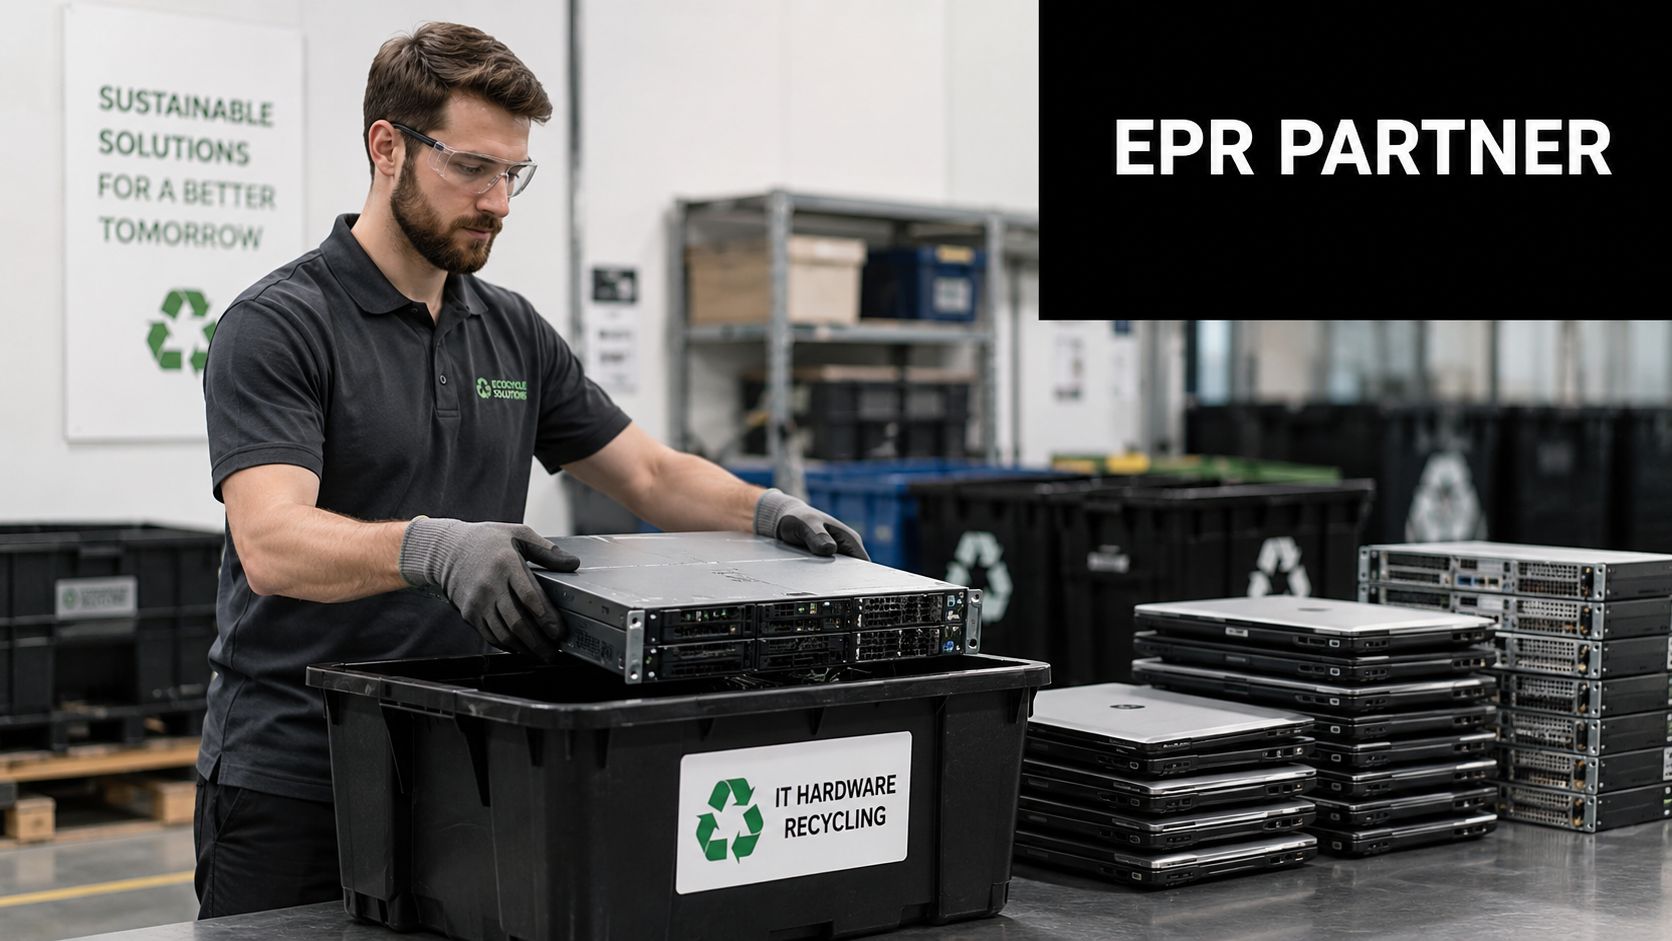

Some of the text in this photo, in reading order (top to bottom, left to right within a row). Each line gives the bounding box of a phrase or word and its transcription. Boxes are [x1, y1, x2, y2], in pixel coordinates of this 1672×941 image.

[99, 85, 274, 127] SUSTAINABLE
[98, 129, 250, 166] SOLUTIONS
[97, 172, 276, 211] FOR A BETTER
[98, 216, 263, 250] TOMORROW
[776, 774, 897, 808] IT HARDWARE
[784, 806, 886, 838] RECYCLING
